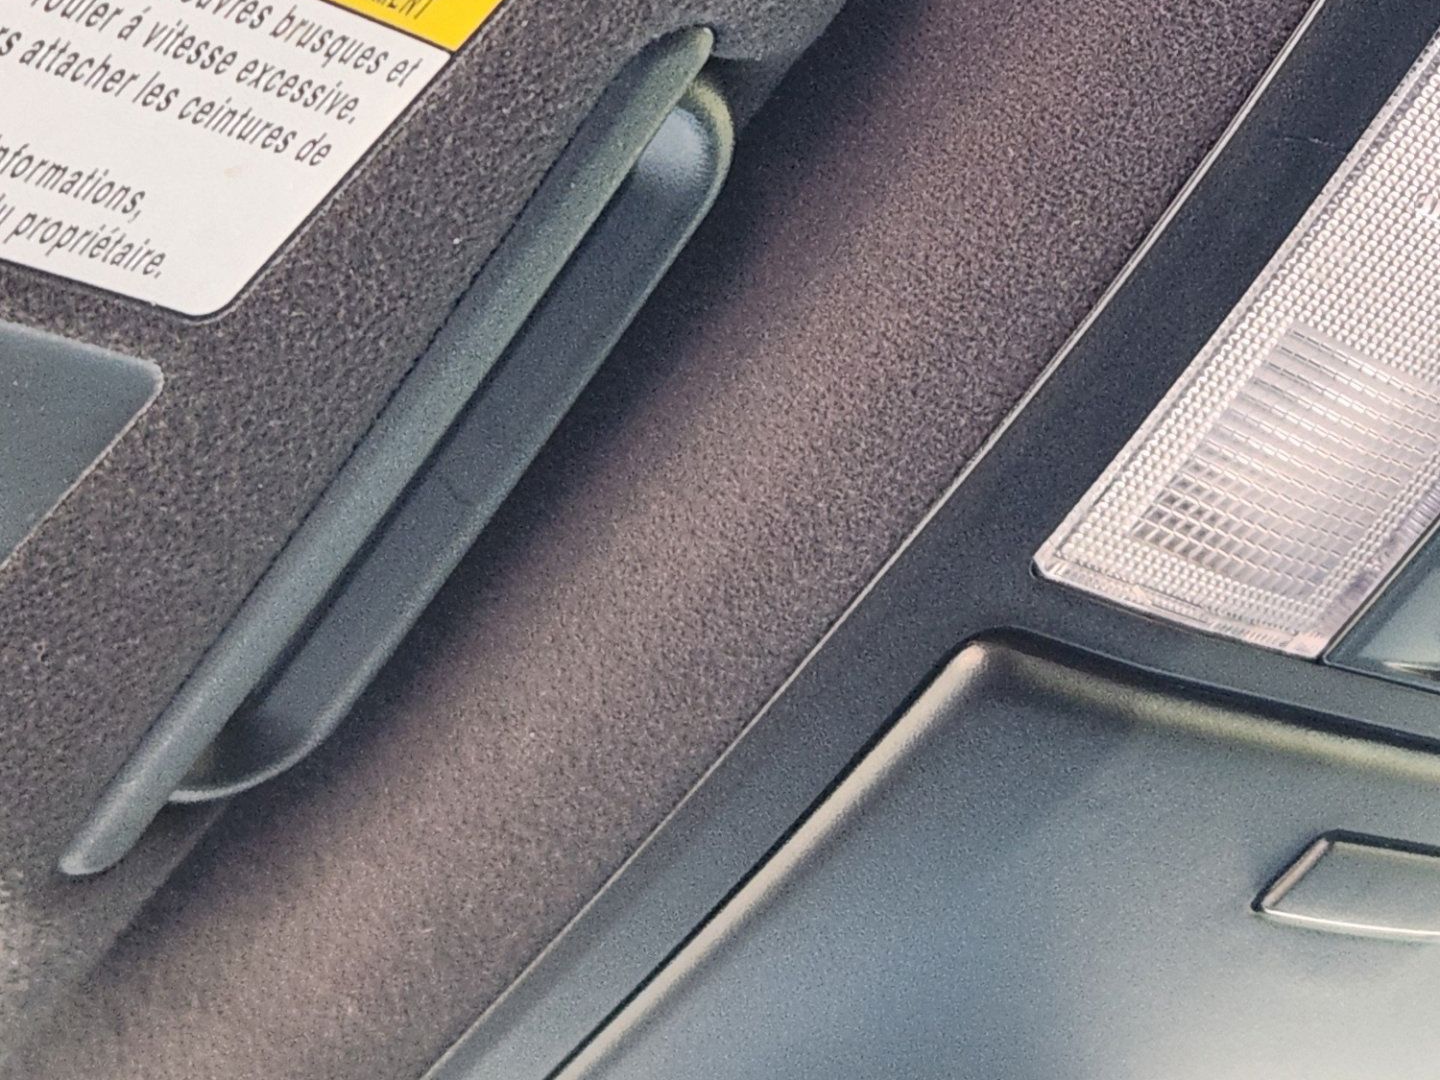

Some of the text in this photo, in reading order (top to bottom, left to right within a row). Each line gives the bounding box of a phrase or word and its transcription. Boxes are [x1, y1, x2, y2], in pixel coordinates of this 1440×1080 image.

[142, 18, 238, 75] vitesse
[235, 58, 360, 124] excessive.
[269, 5, 389, 76] brusques
[386, 57, 423, 88] et
[18, 37, 141, 98] attacher
[132, 71, 181, 112] les
[177, 96, 298, 155] ceintures
[294, 132, 333, 167] de
